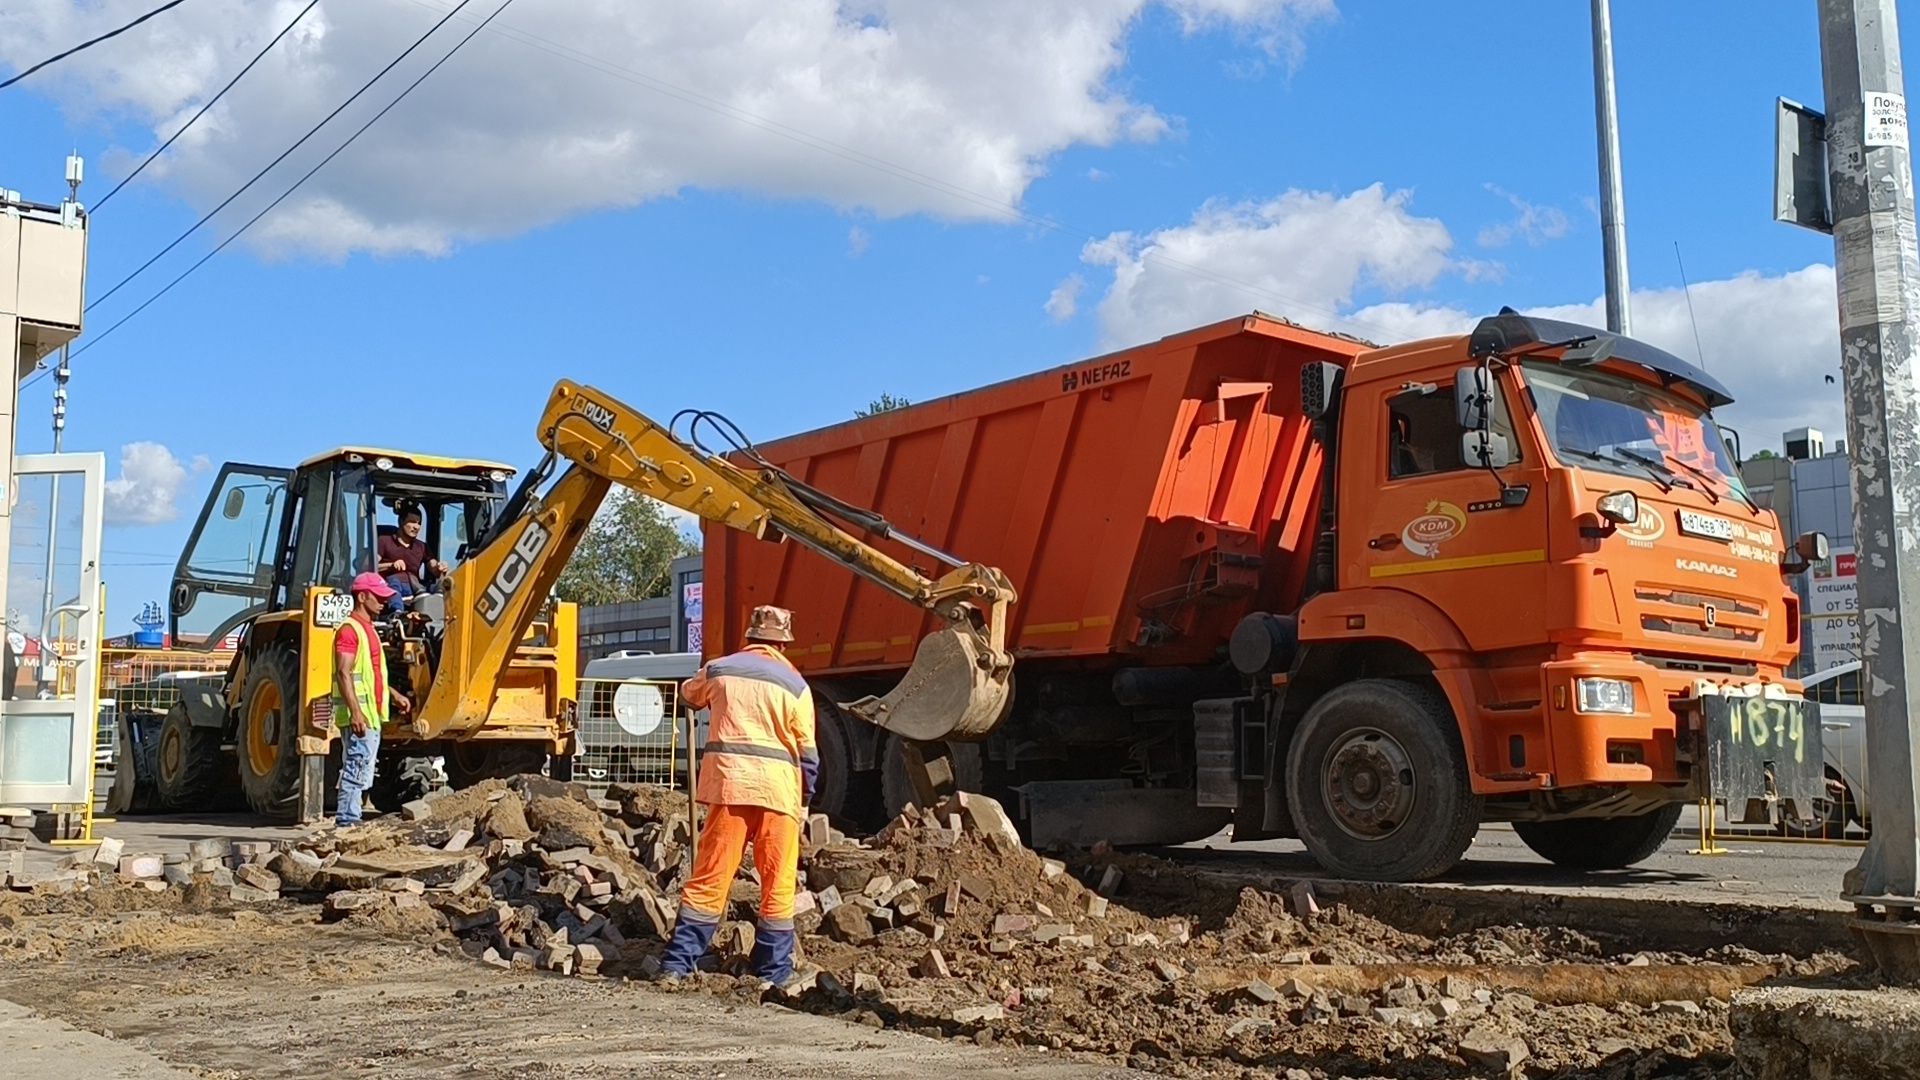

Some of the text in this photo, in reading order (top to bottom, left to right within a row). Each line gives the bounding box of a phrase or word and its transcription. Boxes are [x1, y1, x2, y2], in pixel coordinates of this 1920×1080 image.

[1081, 360, 1131, 386] NEFAZ
[1419, 520, 1448, 531] KDM
[485, 521, 548, 621] JCB
[1676, 559, 1738, 578] KAMAZ
[322, 595, 351, 608] 5493
[320, 610, 334, 620] ХН
[1826, 618, 1843, 630] ДО
